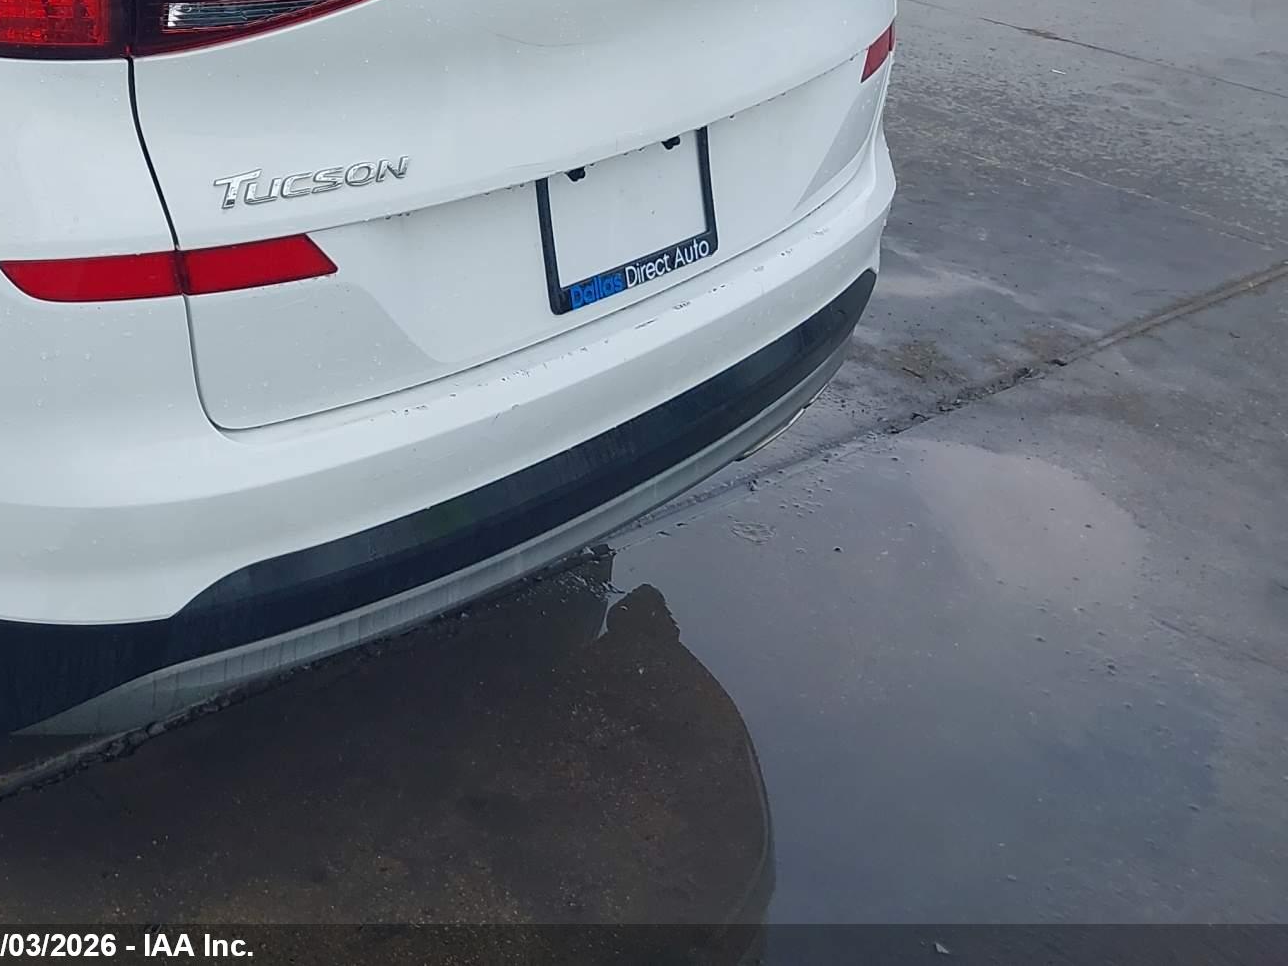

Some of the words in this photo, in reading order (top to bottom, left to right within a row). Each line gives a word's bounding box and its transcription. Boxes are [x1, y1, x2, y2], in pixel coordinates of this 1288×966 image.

[570, 272, 623, 309] Dallas
[625, 254, 671, 289] Direct
[674, 238, 710, 270] Auto
